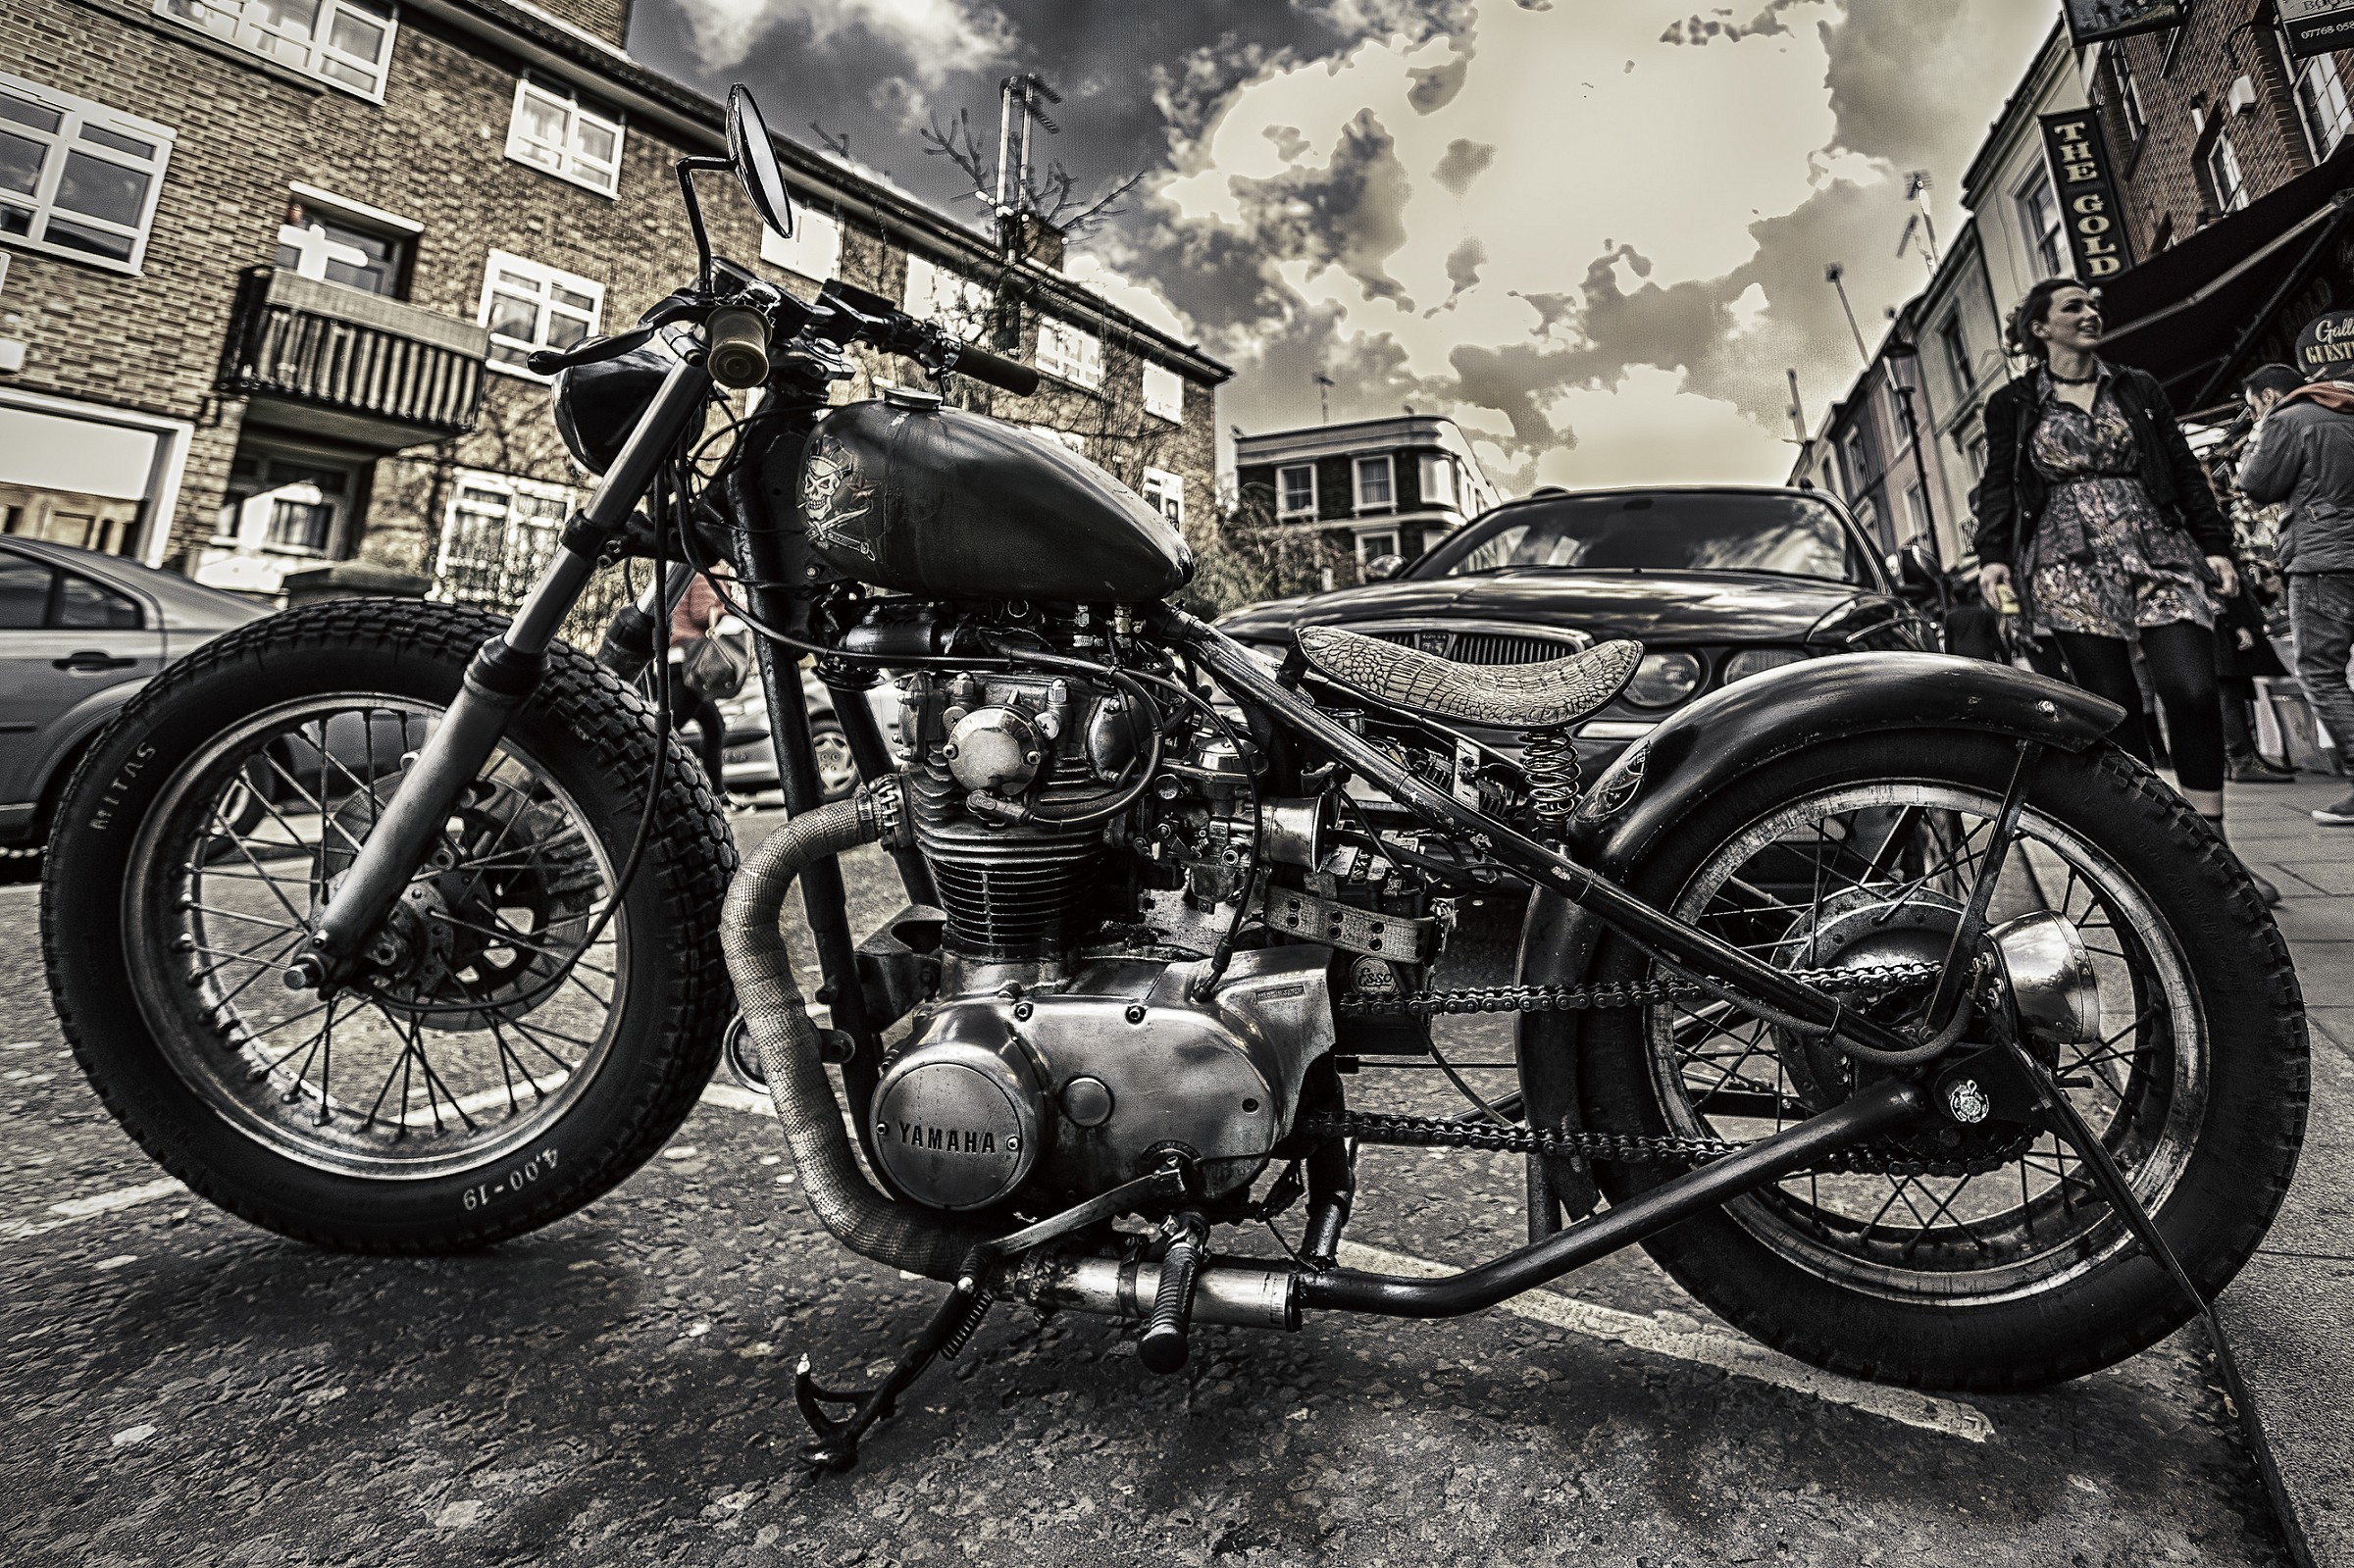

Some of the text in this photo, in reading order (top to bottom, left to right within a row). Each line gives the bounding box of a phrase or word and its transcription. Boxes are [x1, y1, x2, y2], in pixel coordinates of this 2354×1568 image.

[2301, 25, 2334, 39] 07768
[2054, 122, 2098, 182] THE
[2073, 193, 2121, 278] GOLD
[2315, 317, 2354, 344] Gall
[2305, 341, 2354, 364] GUEST
[89, 742, 156, 830] MITAS
[1358, 968, 1392, 986] Esso
[898, 1122, 996, 1154] YAMAHA
